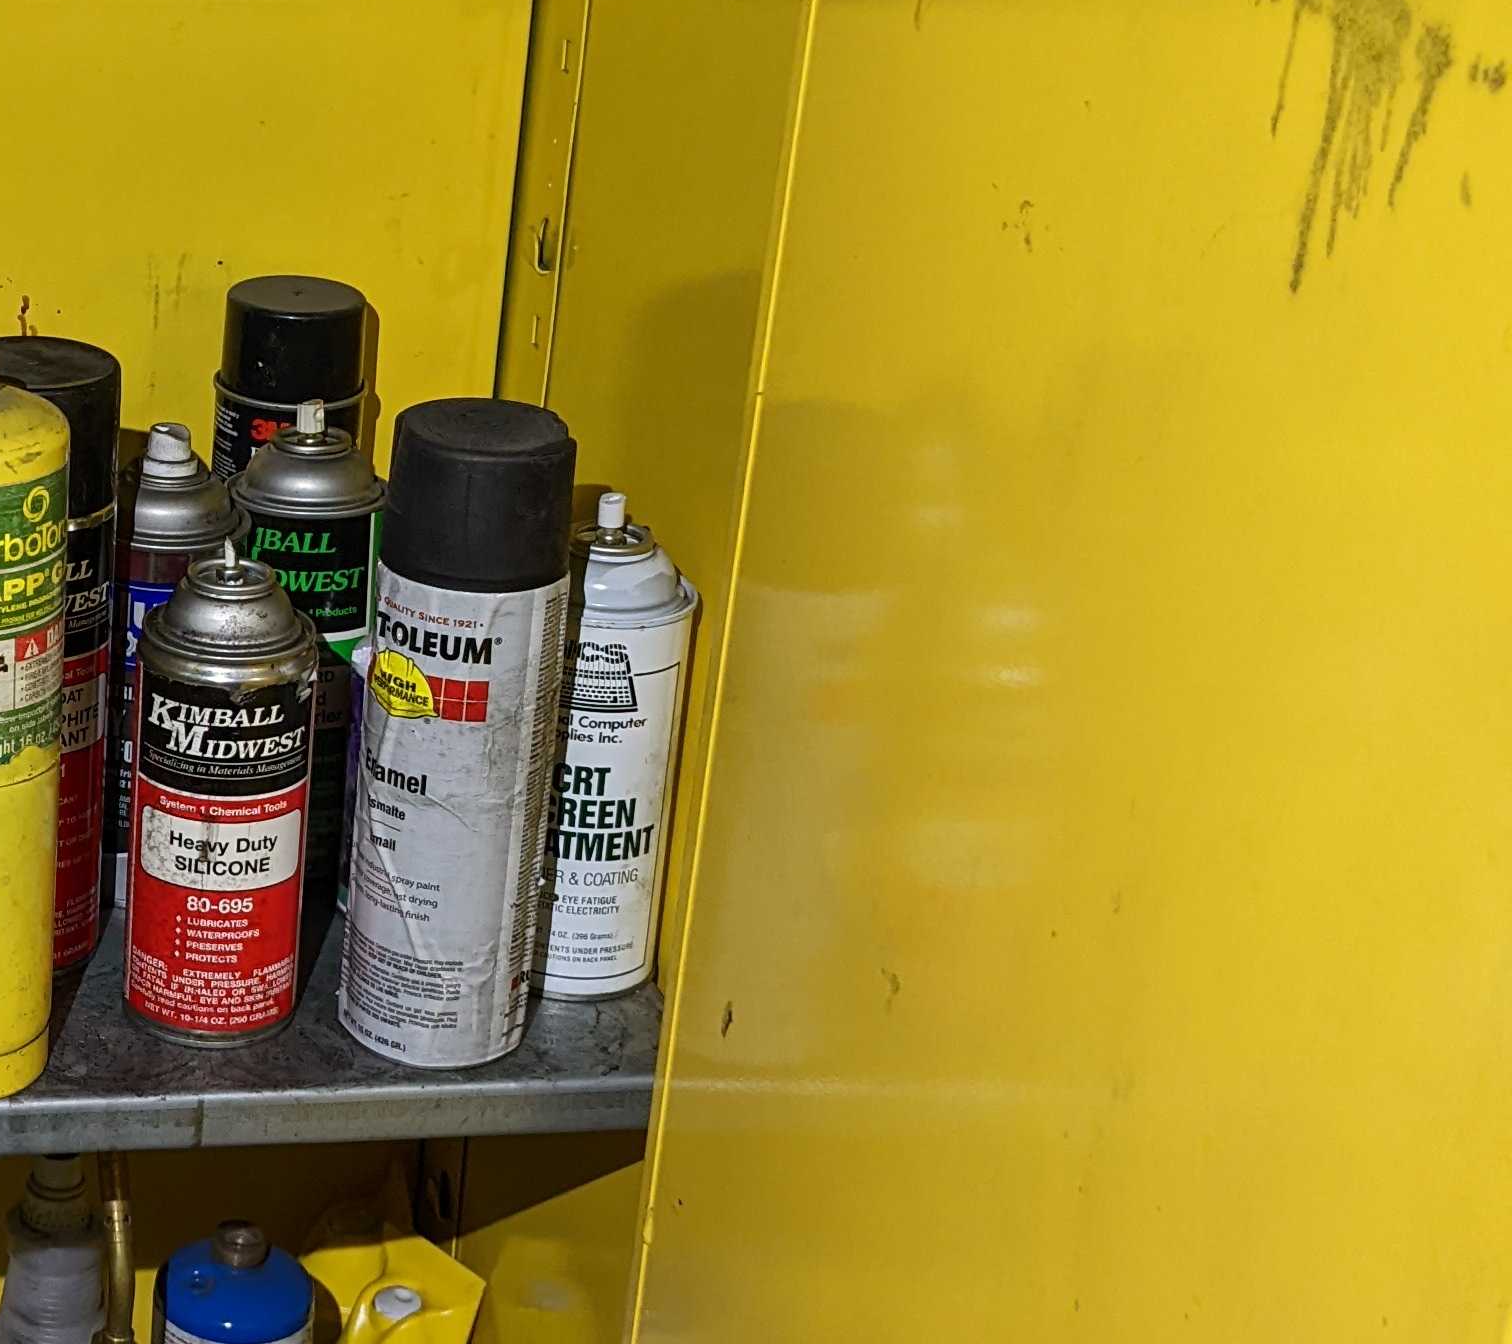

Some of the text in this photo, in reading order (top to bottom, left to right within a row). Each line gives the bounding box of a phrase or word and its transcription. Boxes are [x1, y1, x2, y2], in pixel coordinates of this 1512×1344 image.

[419, 612, 449, 626] SINCE
[453, 619, 477, 629] 1921
[148, 692, 285, 731] KIMBALL
[579, 716, 647, 730] Computer
[166, 719, 305, 759] MIDWEST
[599, 732, 623, 744] Inc.
[552, 762, 611, 796] CRT
[160, 795, 196, 813] System
[209, 803, 261, 817] Chemical
[264, 800, 287, 814] Tools
[170, 831, 278, 856] Heavy Duty
[174, 856, 271, 876] SILICONE
[569, 868, 638, 886] & COATING
[416, 879, 440, 892] paint
[187, 896, 254, 914] 80-695
[409, 896, 438, 909] drying
[562, 896, 617, 905] EYE FATIGUE
[566, 906, 620, 916] ELECTRICITY
[187, 916, 248, 928] LUBRICATES
[186, 940, 243, 952] PRESERVES
[185, 952, 238, 964] PROTECTS
